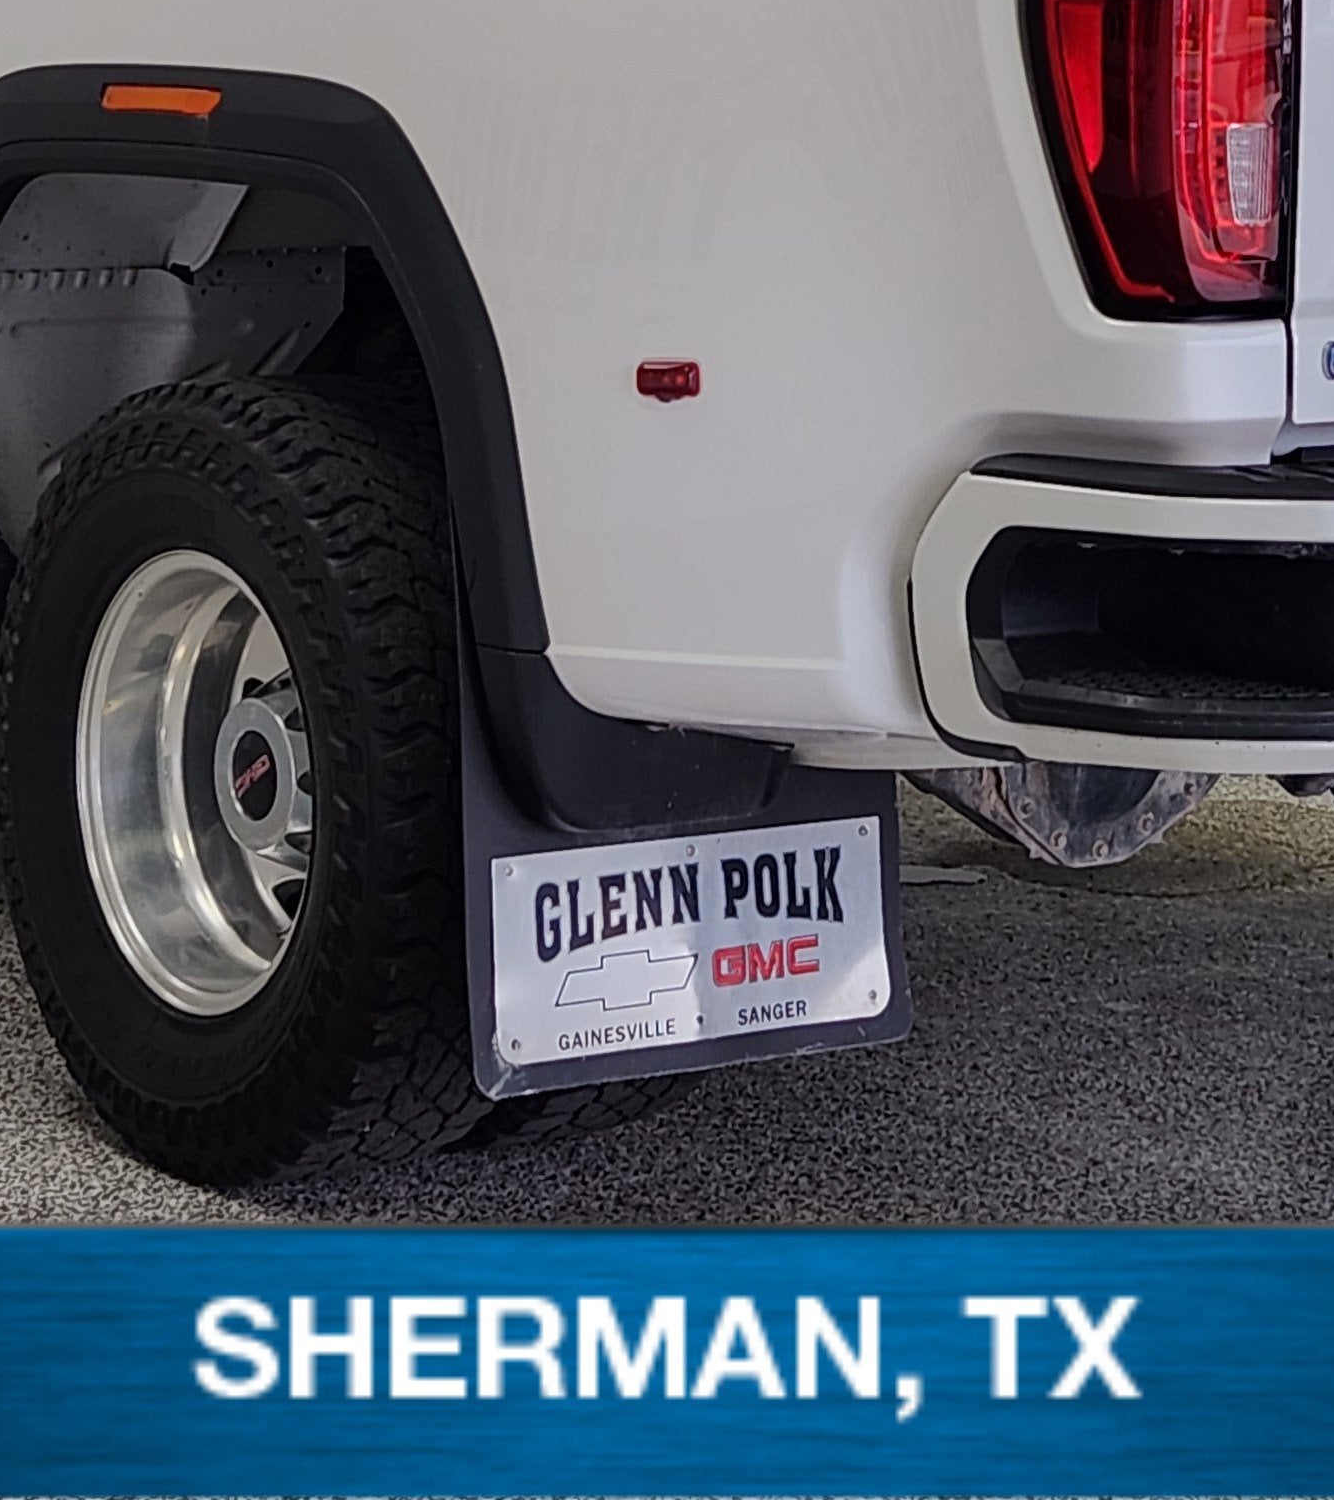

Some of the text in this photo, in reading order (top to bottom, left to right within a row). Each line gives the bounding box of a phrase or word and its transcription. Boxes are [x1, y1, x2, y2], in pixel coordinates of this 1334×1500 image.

[534, 845, 845, 963] GLENN POLK
[711, 932, 820, 988] GMC
[557, 999, 808, 1052] GAINESVILLE SANGER
